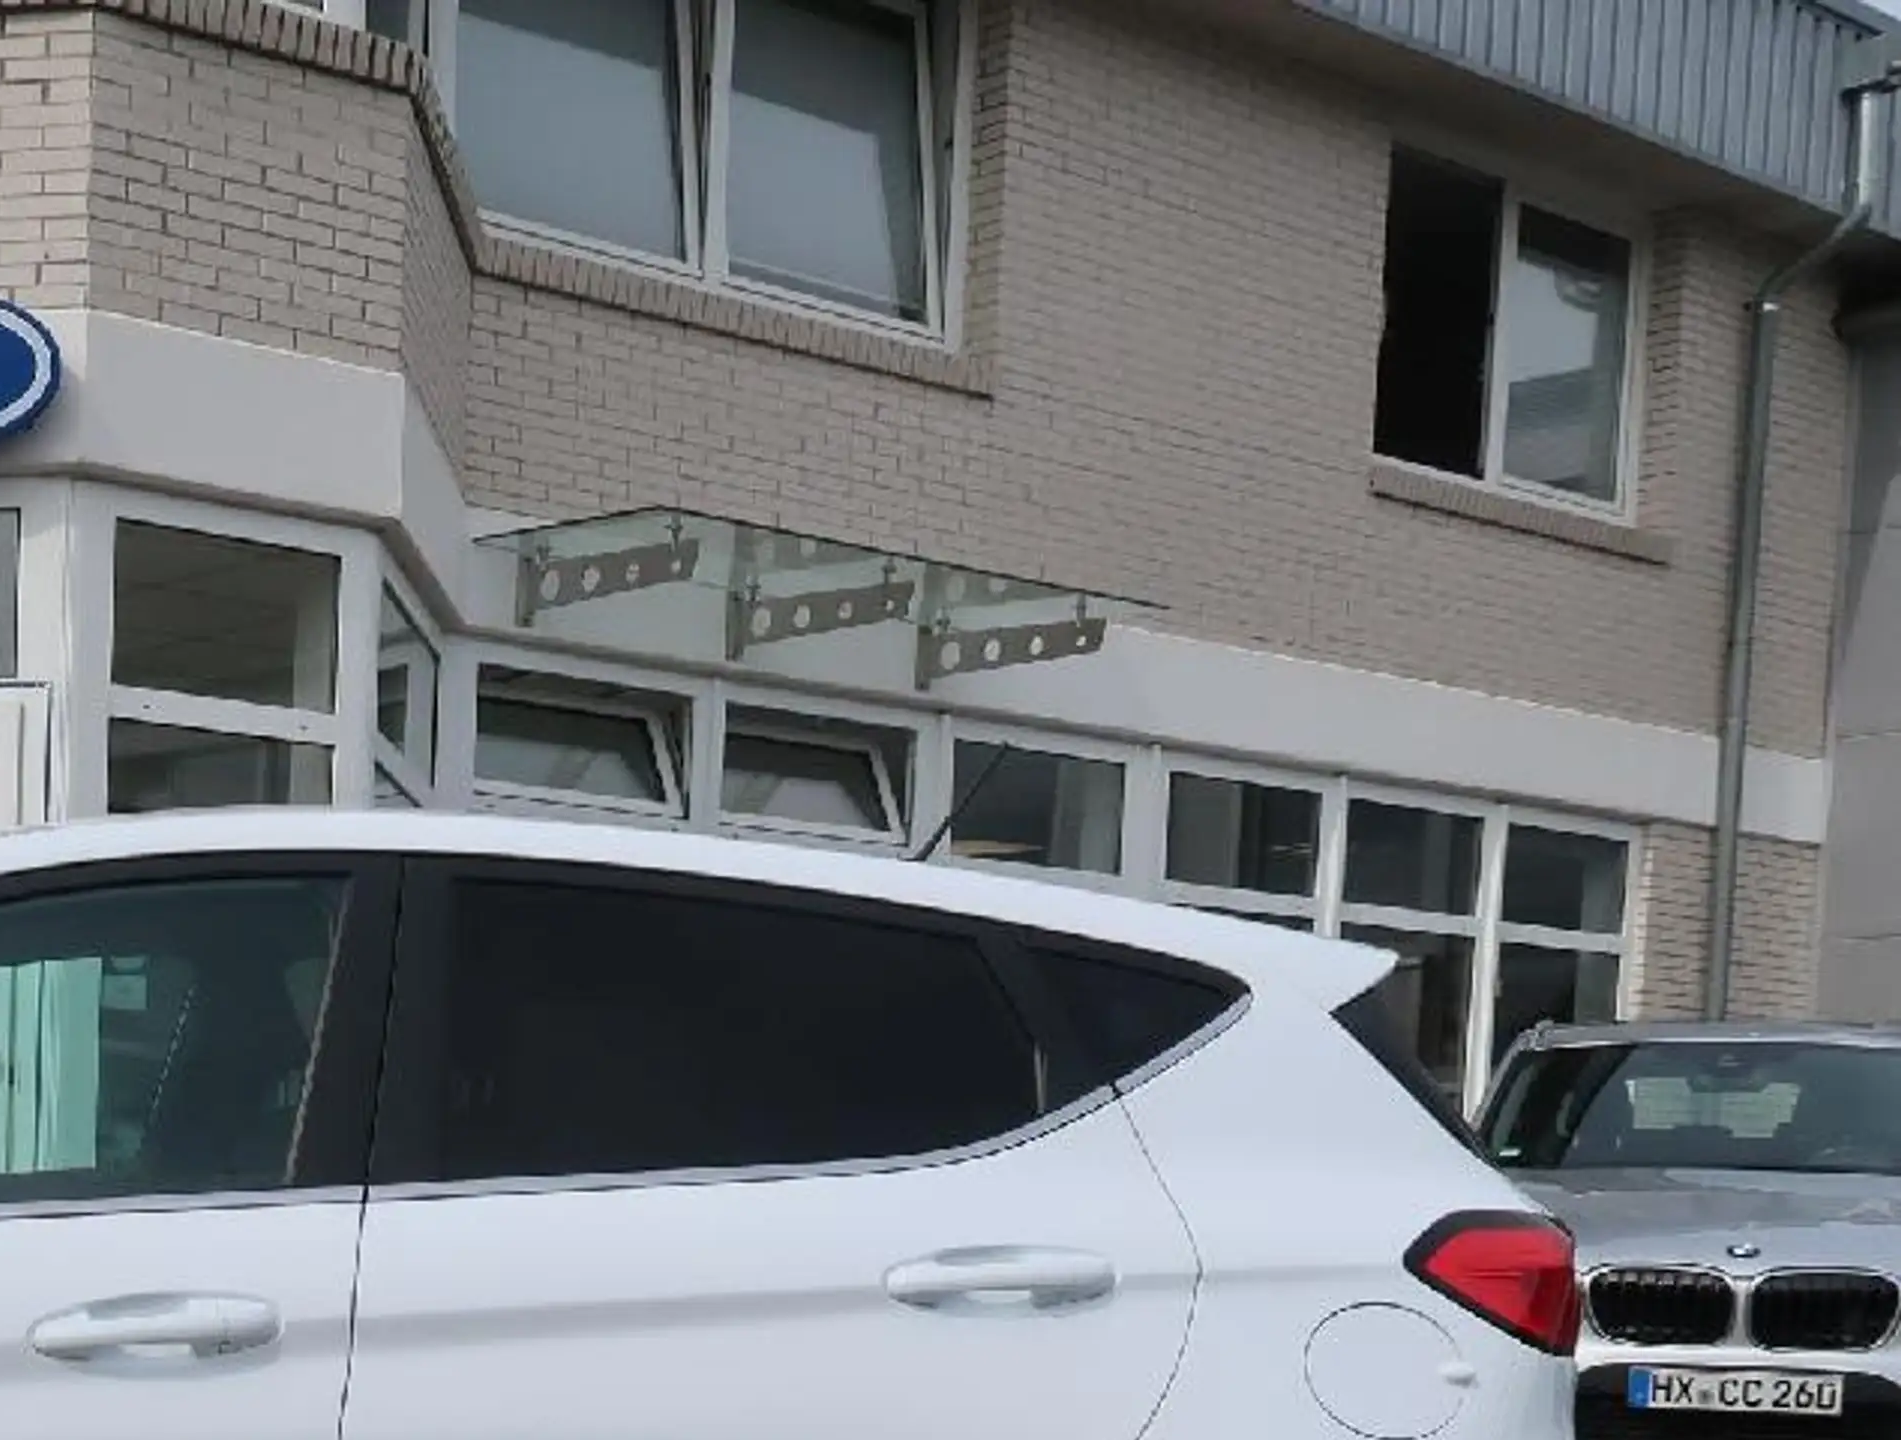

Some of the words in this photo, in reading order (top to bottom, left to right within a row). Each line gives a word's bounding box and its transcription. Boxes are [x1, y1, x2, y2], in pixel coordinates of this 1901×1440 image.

[1651, 1373, 1695, 1405] HX
[1718, 1378, 1763, 1408] CC
[1771, 1379, 1837, 1410] 260
